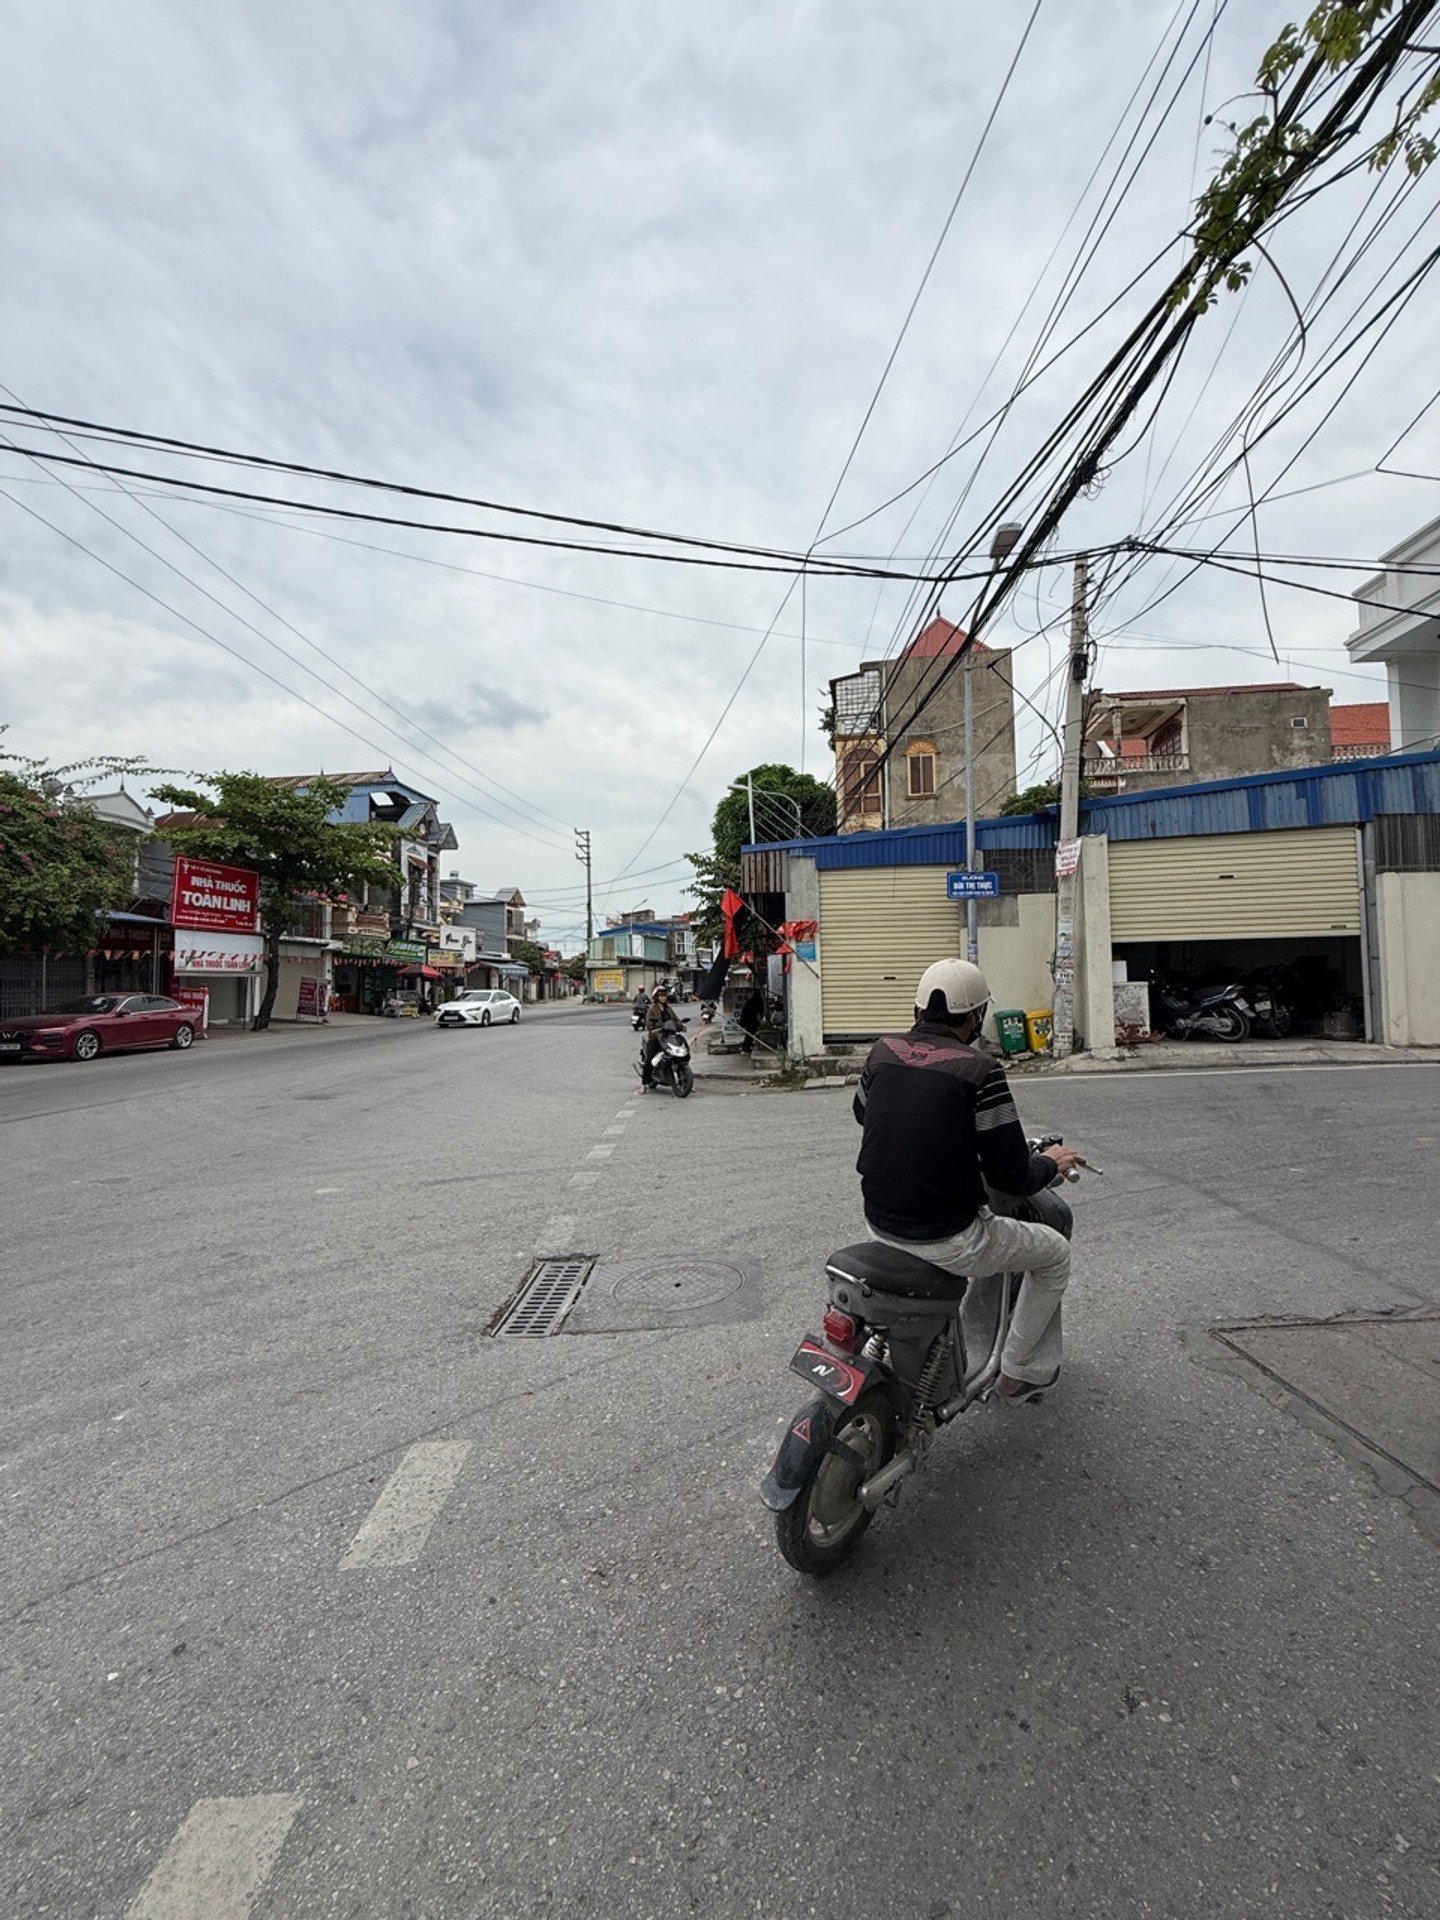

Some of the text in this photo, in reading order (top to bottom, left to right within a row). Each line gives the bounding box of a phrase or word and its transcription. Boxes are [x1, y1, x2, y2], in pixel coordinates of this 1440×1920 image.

[191, 875, 247, 894] NHÀ THUỐC
[181, 889, 222, 910] TOÀN
[222, 896, 251, 913] LINH
